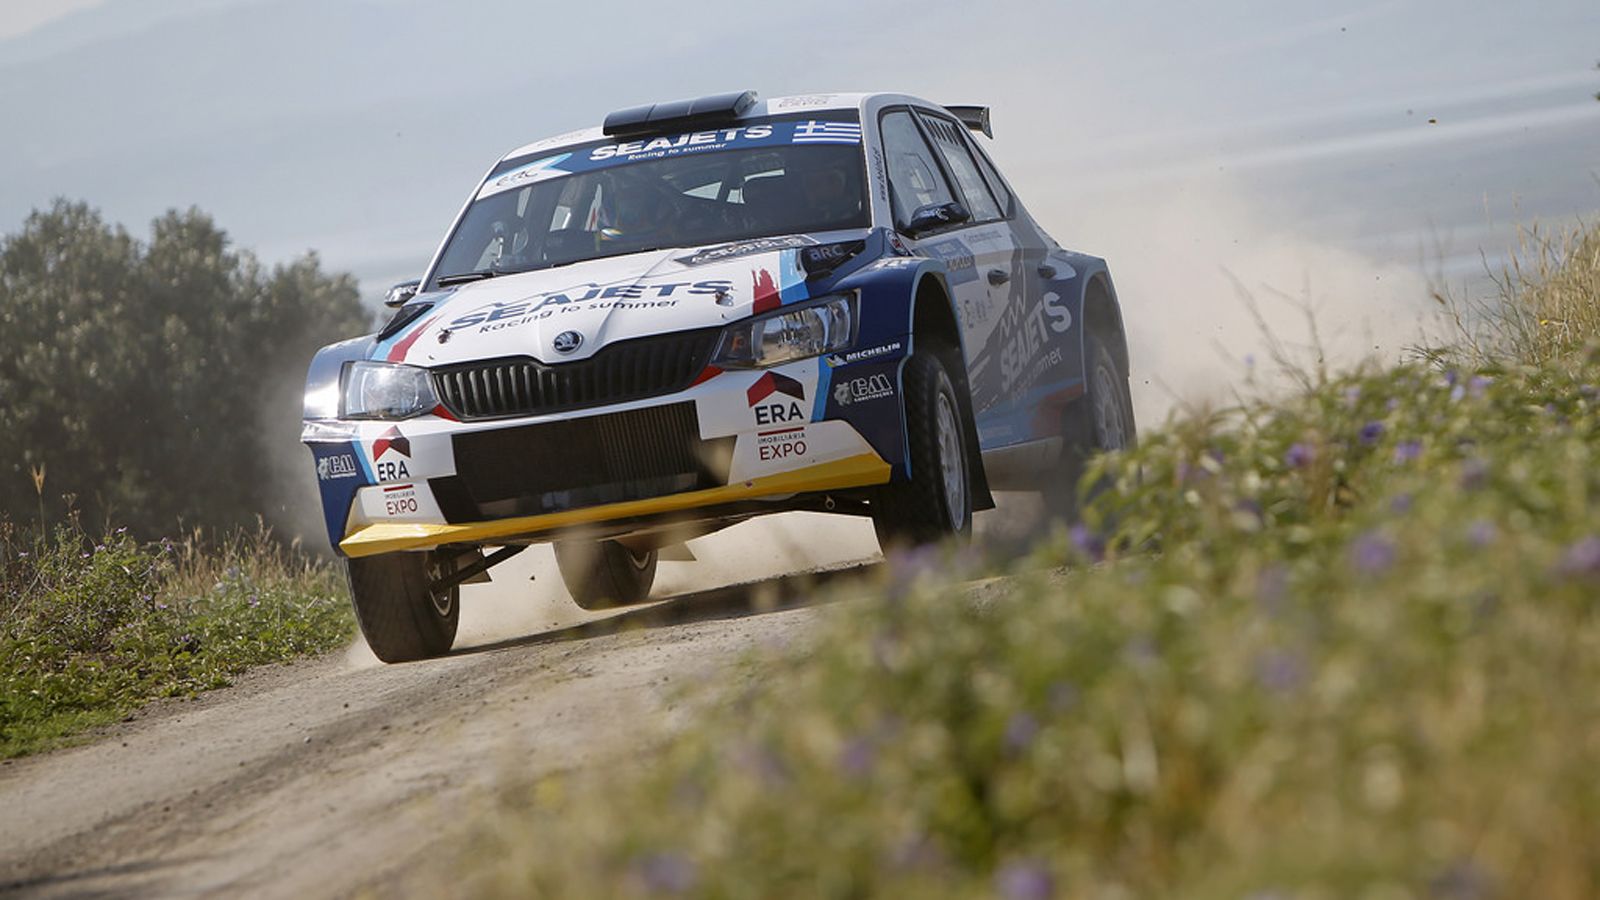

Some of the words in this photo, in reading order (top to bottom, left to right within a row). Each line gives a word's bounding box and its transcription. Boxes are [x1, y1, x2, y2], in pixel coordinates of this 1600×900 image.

[589, 124, 773, 161] SEAJETS
[628, 150, 665, 160] Racing
[683, 143, 727, 152] summer
[448, 280, 733, 331] SEAJETS
[479, 309, 553, 333] Racing
[561, 304, 581, 314] to
[588, 299, 680, 311] summer
[846, 342, 901, 362] MICHELIN
[1001, 291, 1072, 393] SEAJETS
[755, 401, 804, 425] ERA
[759, 441, 807, 460] EXPO
[377, 461, 410, 482] ERA
[386, 498, 417, 515] EXPO
